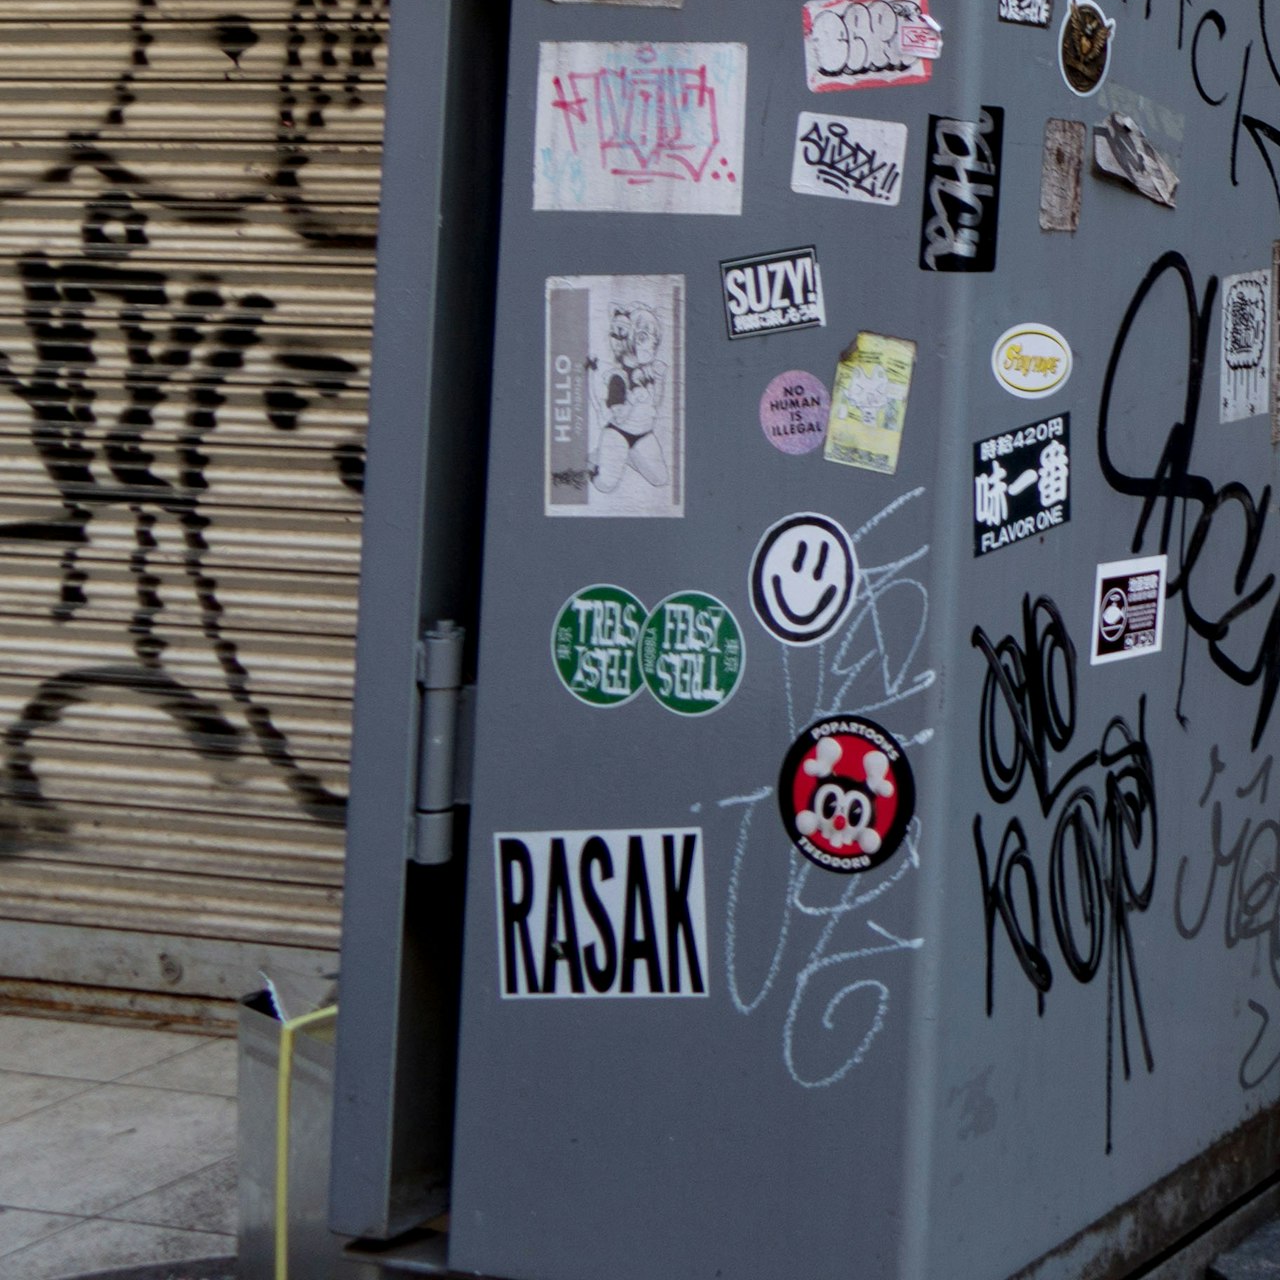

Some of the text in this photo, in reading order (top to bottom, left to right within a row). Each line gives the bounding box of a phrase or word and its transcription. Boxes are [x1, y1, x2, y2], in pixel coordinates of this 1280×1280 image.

[726, 257, 816, 315] SUZY!
[554, 355, 572, 443] HELLO
[770, 396, 820, 411] HUMAN
[783, 385, 805, 397] NO
[772, 421, 822, 436] ILLEGAL
[790, 410, 802, 421] IS
[980, 416, 1063, 461] 時給420円
[975, 439, 1068, 526] 味一番
[981, 505, 1063, 552] FLAVOR ONE
[810, 721, 900, 762] POPARTOONS
[500, 834, 706, 995] RASAK
